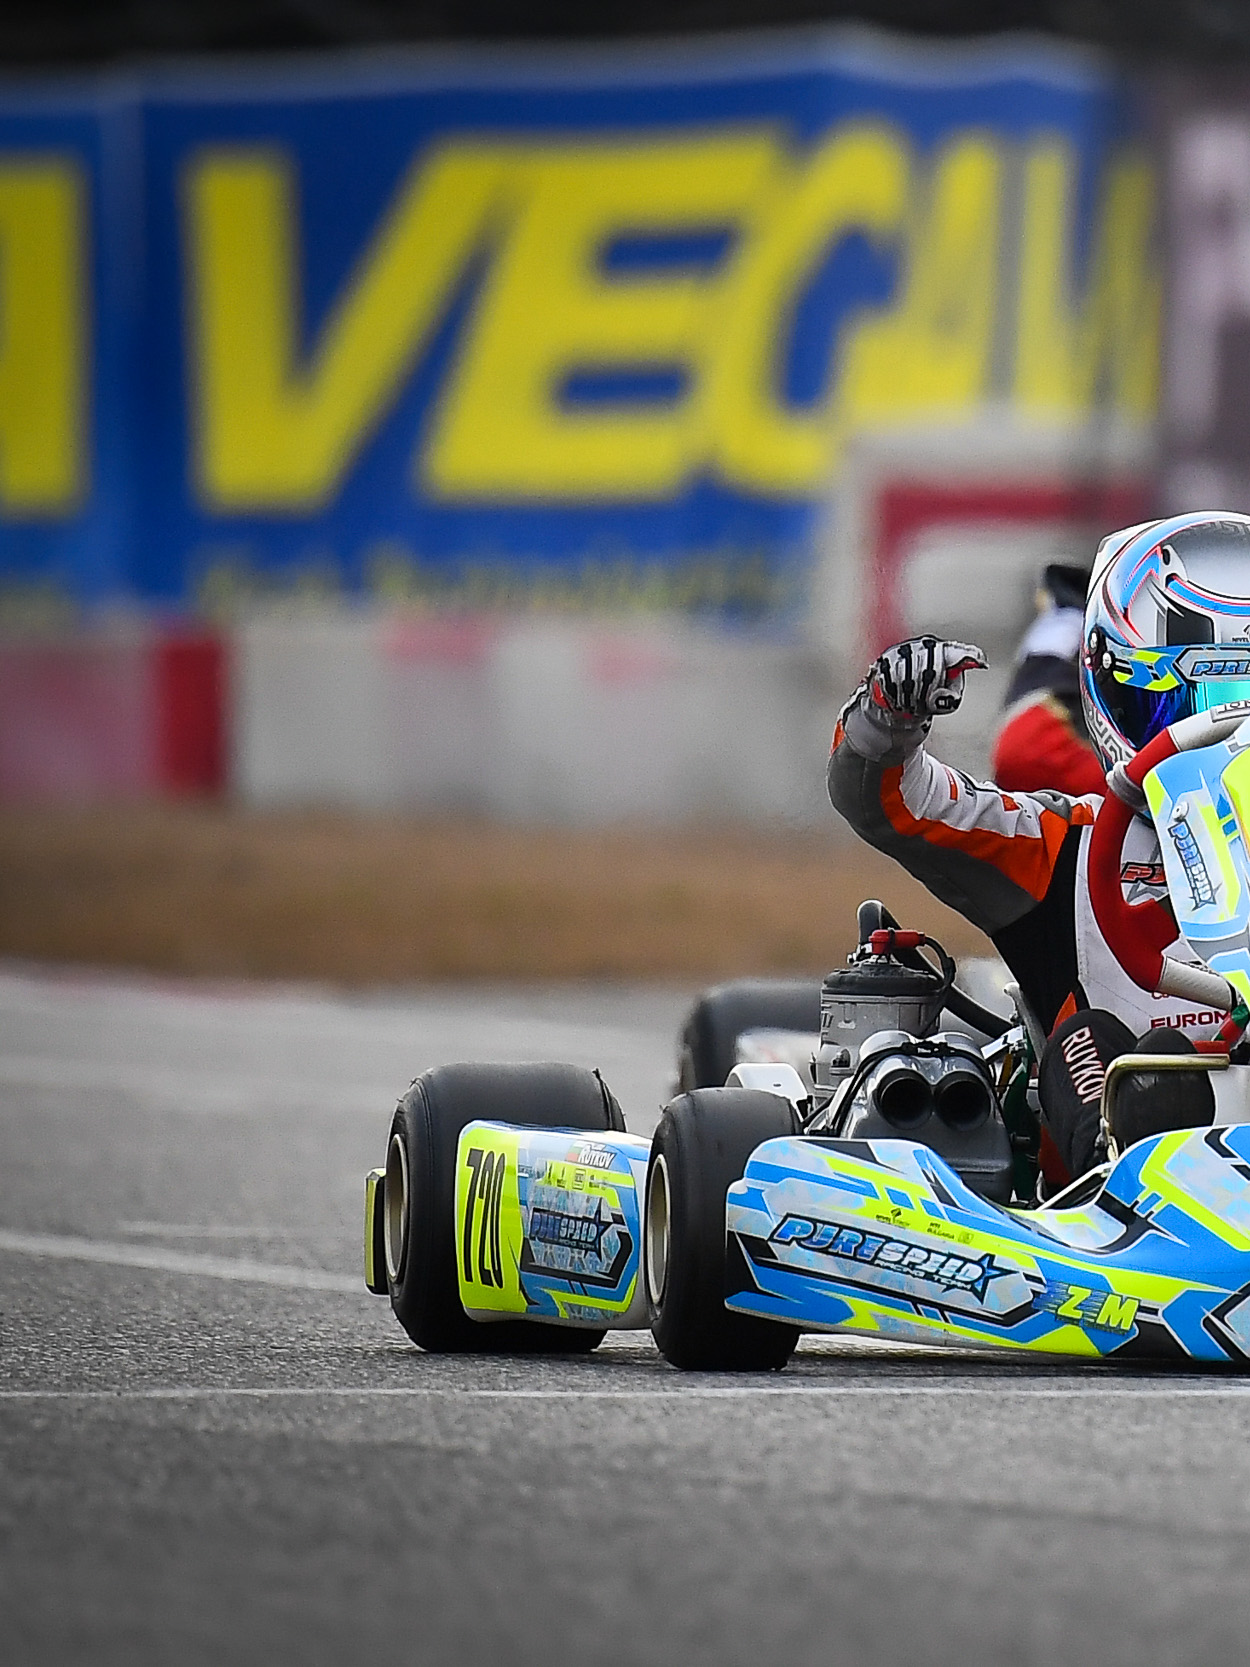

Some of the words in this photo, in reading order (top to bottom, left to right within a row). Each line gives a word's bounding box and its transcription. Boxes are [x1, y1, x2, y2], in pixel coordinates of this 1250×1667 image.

[463, 1147, 507, 1290] 720
[773, 1216, 984, 1281] PURESPEED
[930, 1274, 974, 1290] TEAM
